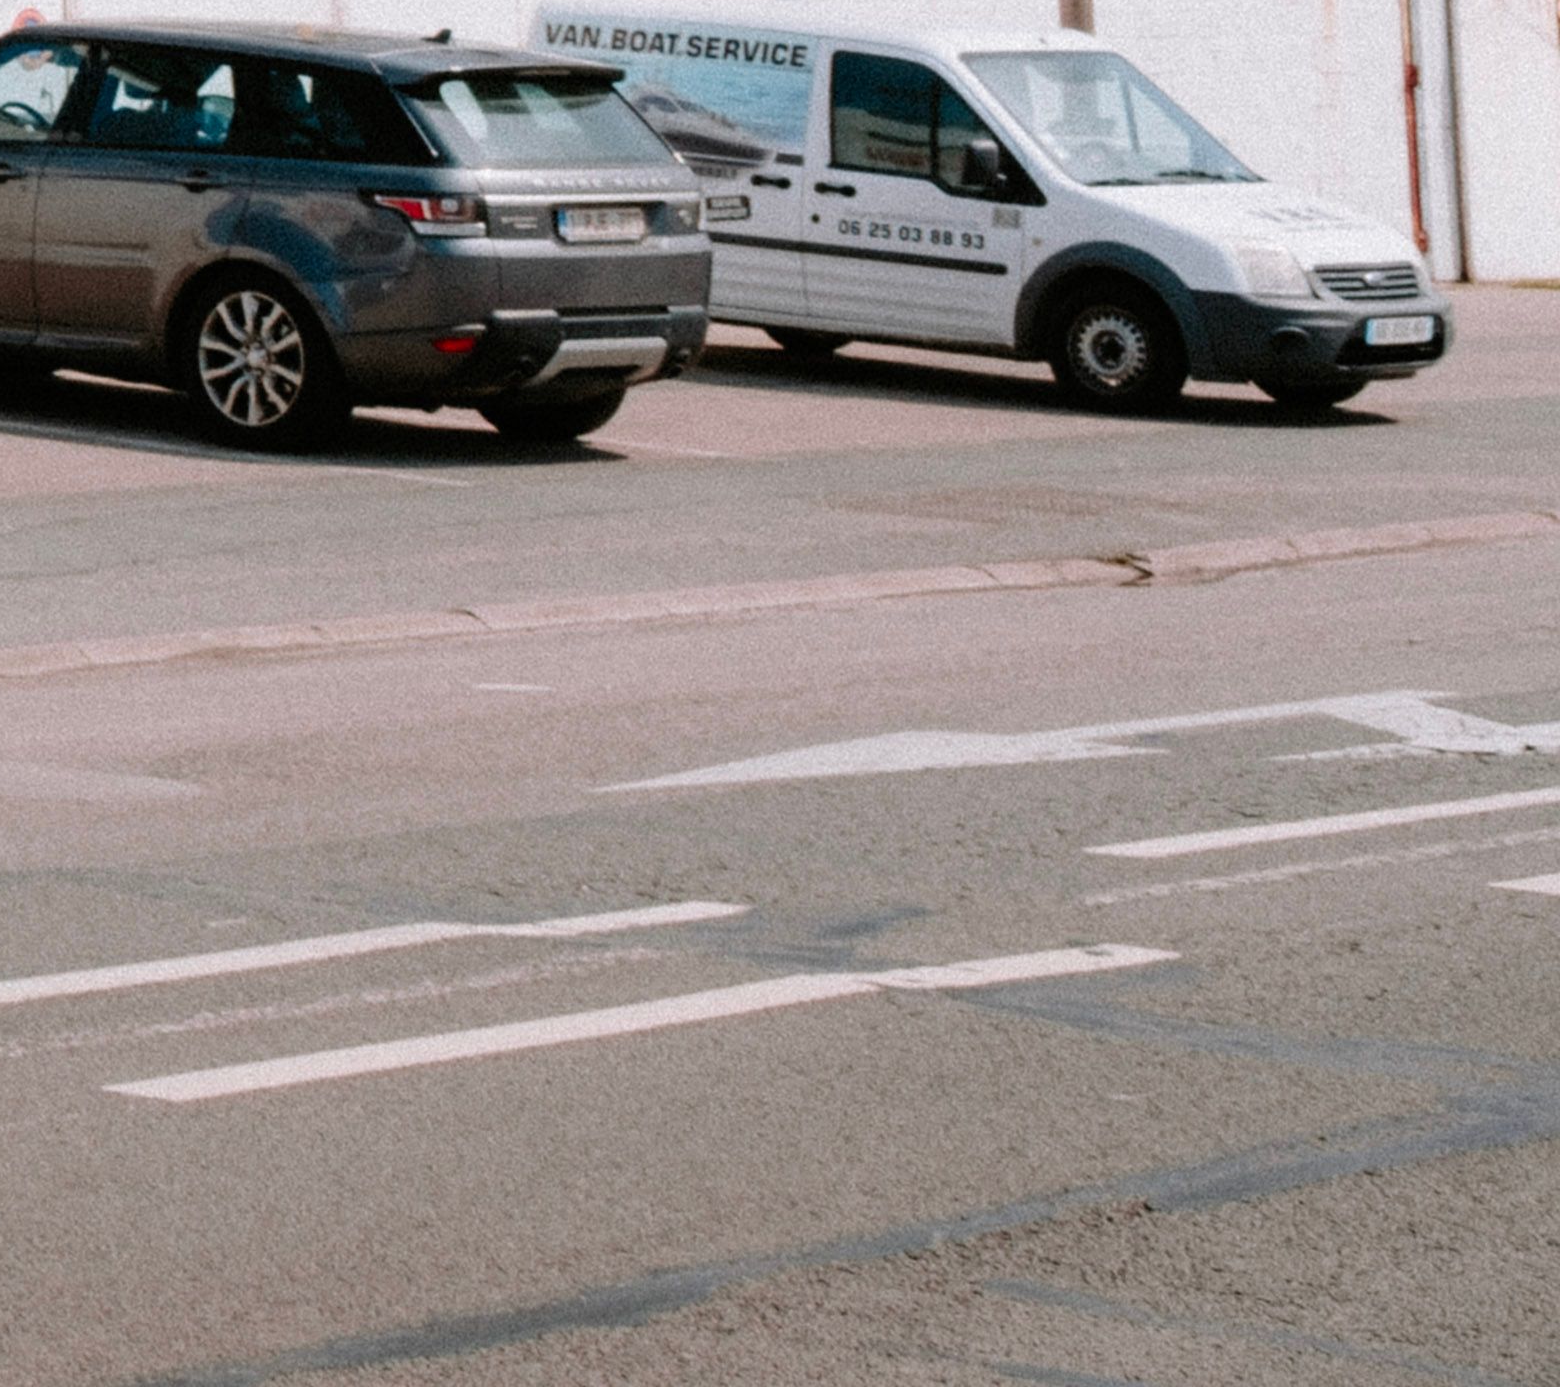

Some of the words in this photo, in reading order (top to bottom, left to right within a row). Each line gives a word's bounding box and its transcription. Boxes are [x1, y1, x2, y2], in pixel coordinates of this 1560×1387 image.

[838, 219, 861, 236] 06
[869, 221, 892, 239] 25
[898, 225, 921, 242] 03
[930, 229, 953, 245] 88
[961, 232, 985, 250] 93
